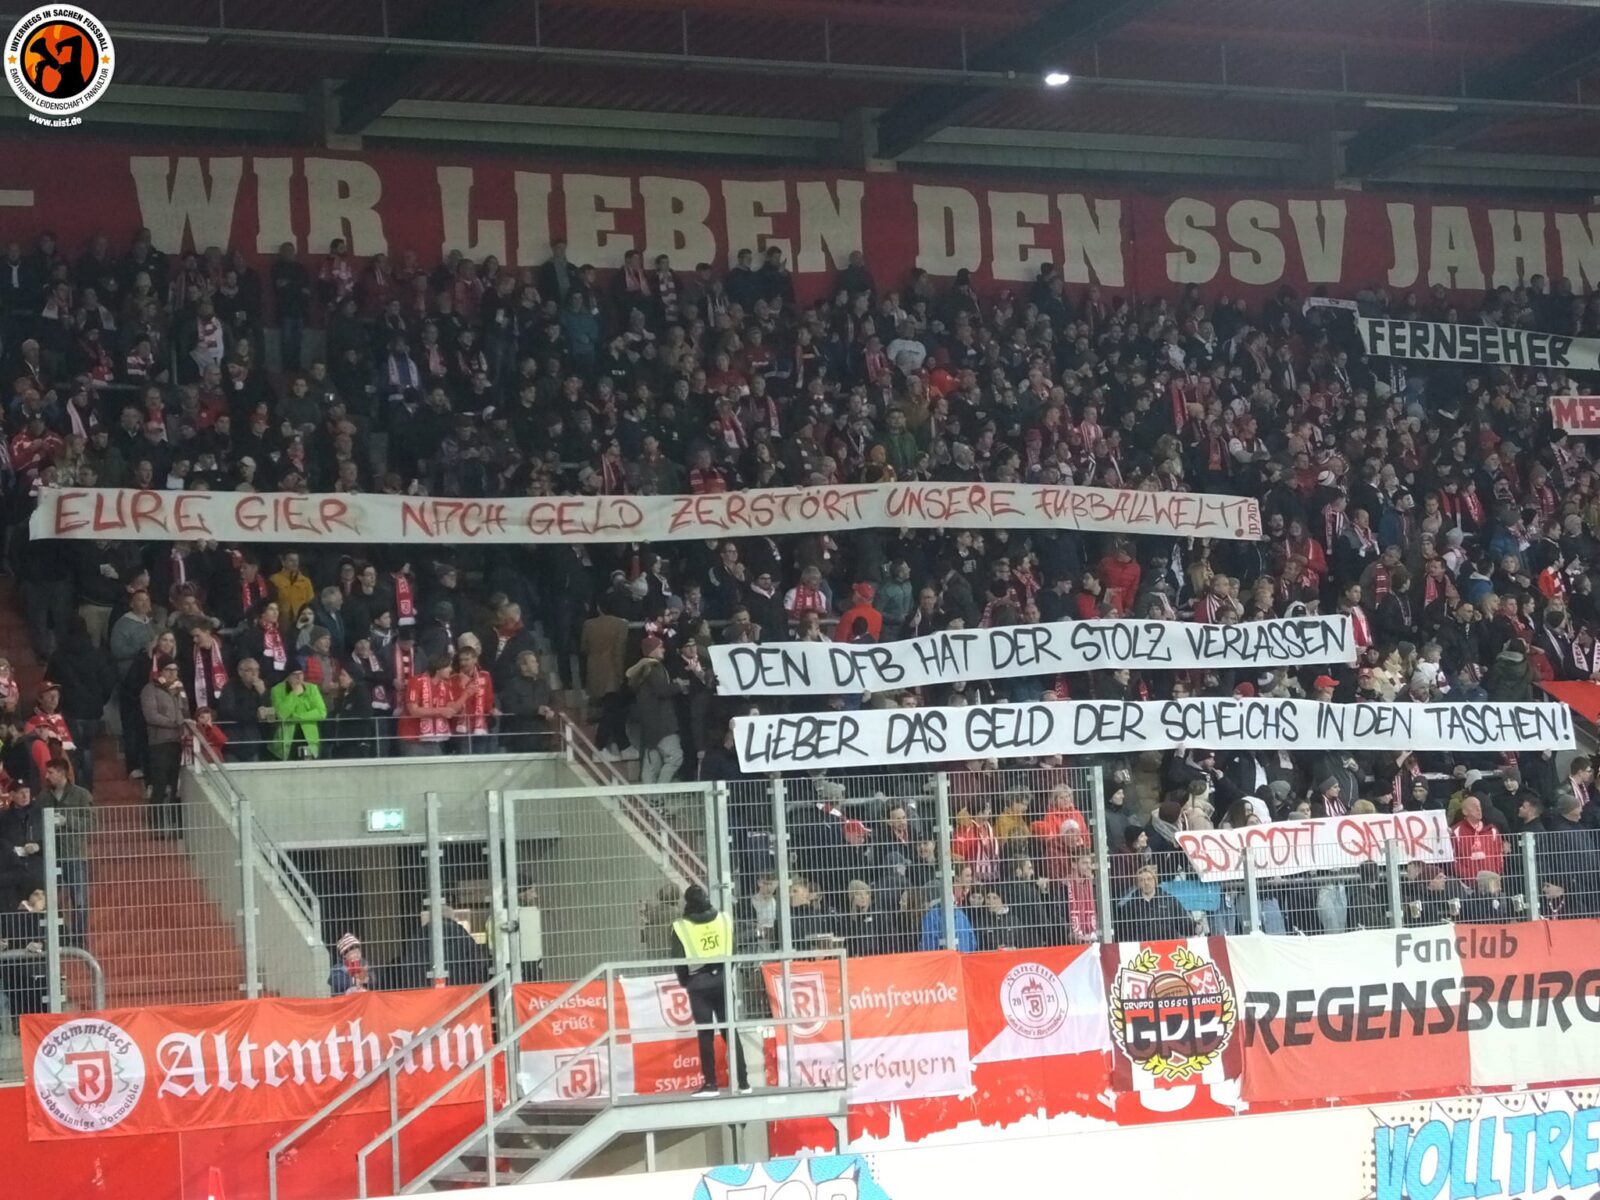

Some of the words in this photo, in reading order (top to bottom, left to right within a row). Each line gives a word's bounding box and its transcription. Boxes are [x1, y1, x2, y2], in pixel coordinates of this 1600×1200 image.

[130, 156, 388, 257] WIR
[437, 166, 863, 273] LIEBEN
[913, 184, 1124, 287] DEN
[1164, 197, 1347, 284] SSV
[1386, 203, 1600, 294] JAHN
[1367, 320, 1572, 367] FERNSEHER
[54, 490, 212, 534] EURE
[235, 496, 361, 535] GIER
[527, 500, 643, 536] GELD
[669, 489, 878, 534] ZERSTÖRT
[885, 485, 1025, 522] UNSERE
[728, 647, 811, 690] DEN
[829, 647, 904, 687] DFB
[913, 634, 978, 677] HAT
[991, 627, 1062, 670] DER
[1071, 622, 1171, 661] STOLZ
[1186, 618, 1347, 663] VERLASSEN
[887, 711, 947, 756] DAS
[965, 705, 1054, 752] GELD
[1073, 703, 1143, 746] DER
[1317, 702, 1346, 741] IN
[1353, 704, 1413, 740] DEN
[1424, 702, 1571, 744] TASCHEN!
[1178, 821, 1326, 872] BOYCOTT
[1337, 815, 1444, 859] QATAR!
[1395, 929, 1518, 968] Fanclub
[528, 995, 608, 1012] Abnsber
[838, 982, 957, 1018] ahnfreunde
[1123, 1000, 1154, 1011] GRUPPO
[1157, 998, 1188, 1008] ROSSO
[1191, 995, 1222, 1006] BIANCO
[1244, 968, 1600, 1055] REGENSBURG
[41, 1023, 132, 1058] Stammtisch
[552, 1015, 595, 1036] grüßt
[156, 1018, 485, 1100] Altenthann
[673, 1055, 700, 1069] den
[655, 1077, 681, 1093] SSV
[683, 1074, 706, 1089] Jah
